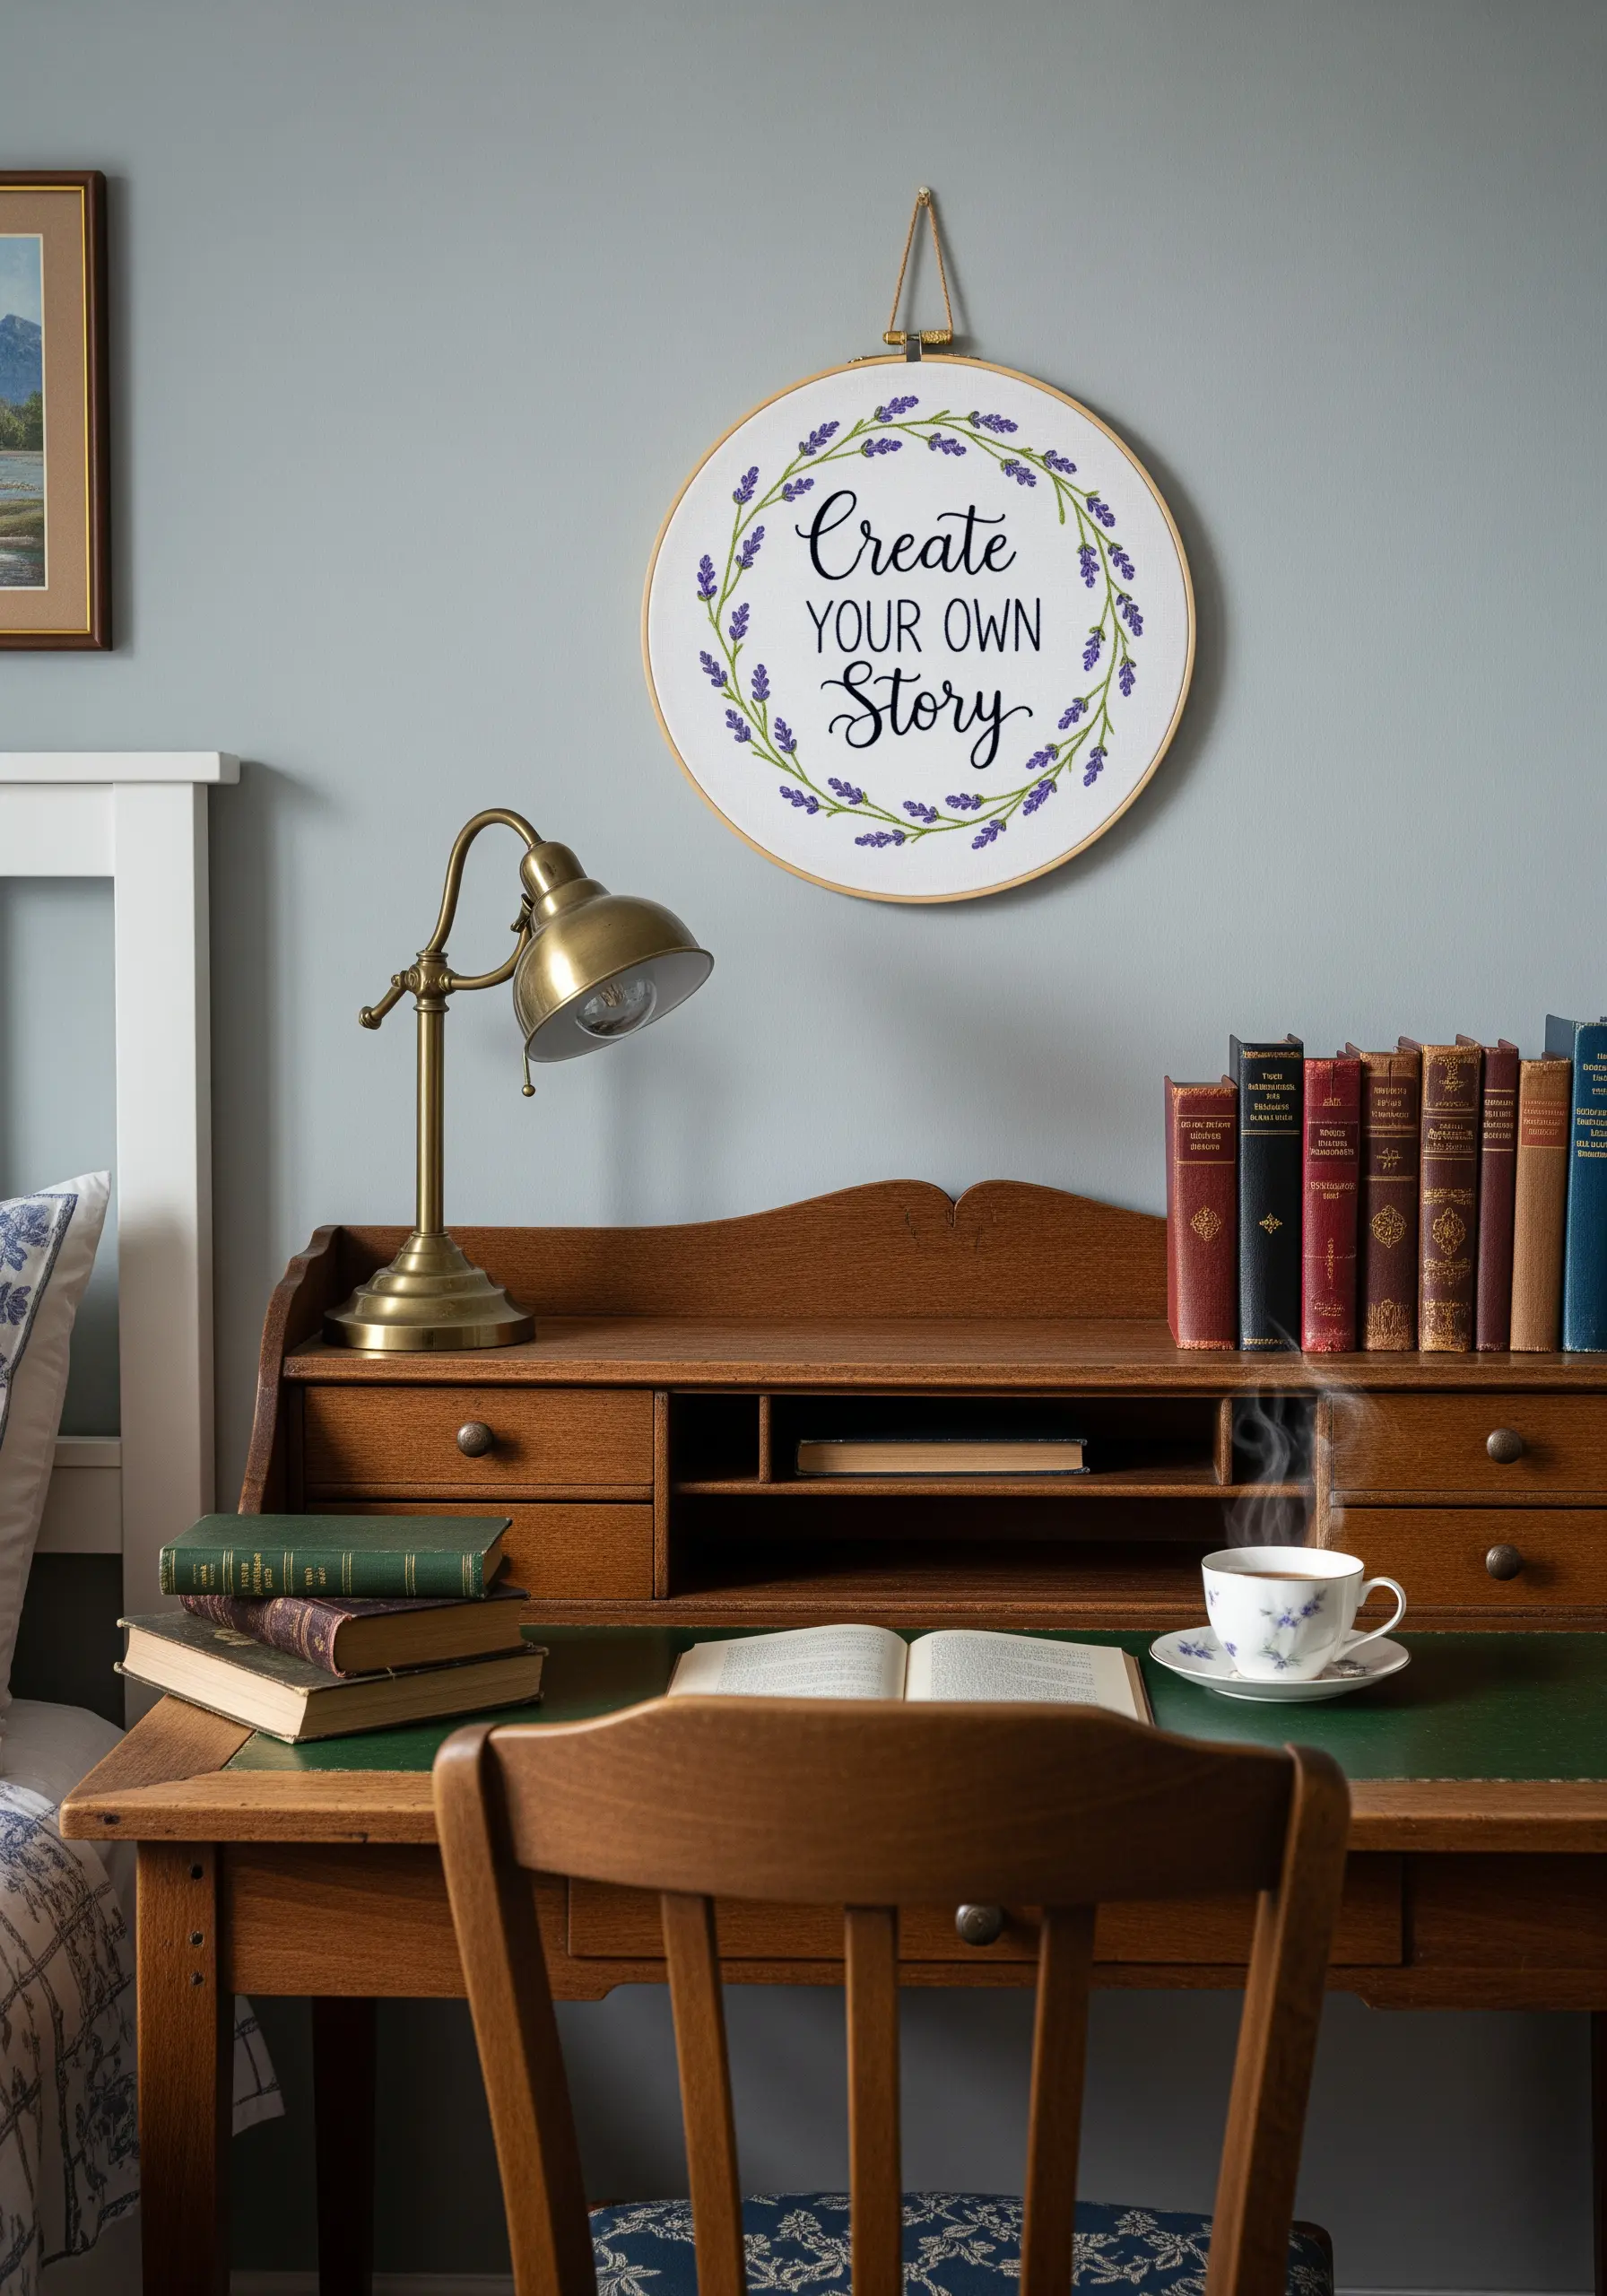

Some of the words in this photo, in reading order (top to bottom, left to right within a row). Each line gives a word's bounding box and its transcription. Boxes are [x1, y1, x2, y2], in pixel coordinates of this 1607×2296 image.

[795, 490, 1017, 580] Create
[806, 599, 922, 653] YOUR
[944, 597, 1040, 653] OWN
[821, 660, 1033, 770] Story
